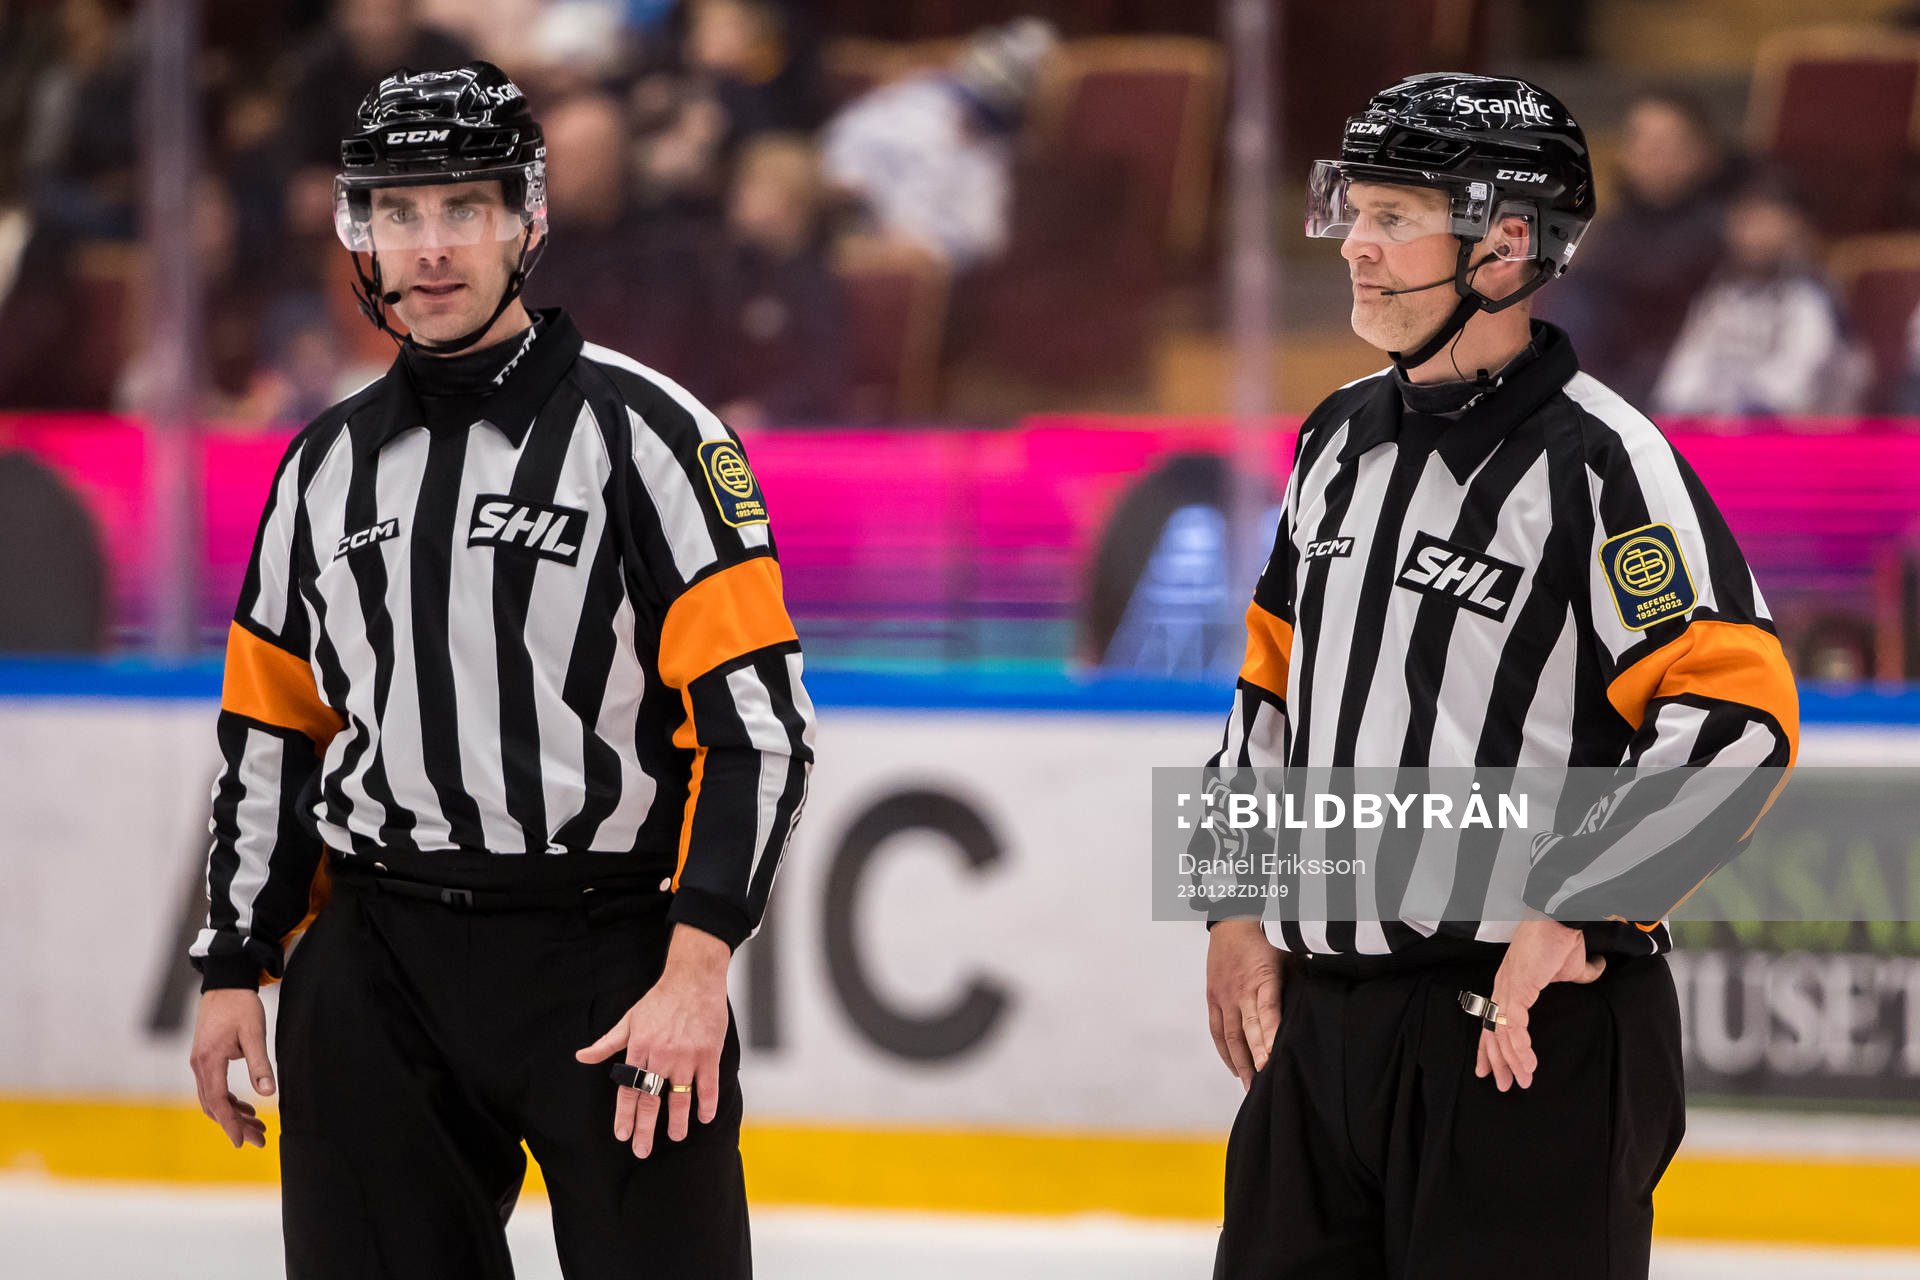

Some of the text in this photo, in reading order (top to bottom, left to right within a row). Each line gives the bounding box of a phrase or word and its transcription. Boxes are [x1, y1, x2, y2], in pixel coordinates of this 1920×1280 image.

[486, 79, 523, 105] Scan
[1455, 95, 1553, 120] Scandic
[386, 129, 450, 145] CCM
[1349, 122, 1388, 136] CCM
[1496, 169, 1548, 185] CCM
[336, 520, 397, 553] CCM
[470, 502, 579, 556] SHL
[1305, 538, 1352, 558] CCM
[1401, 546, 1507, 611] SHL
[1635, 599, 1683, 620] 1922-2022
[1637, 592, 1677, 612] REFEREE
